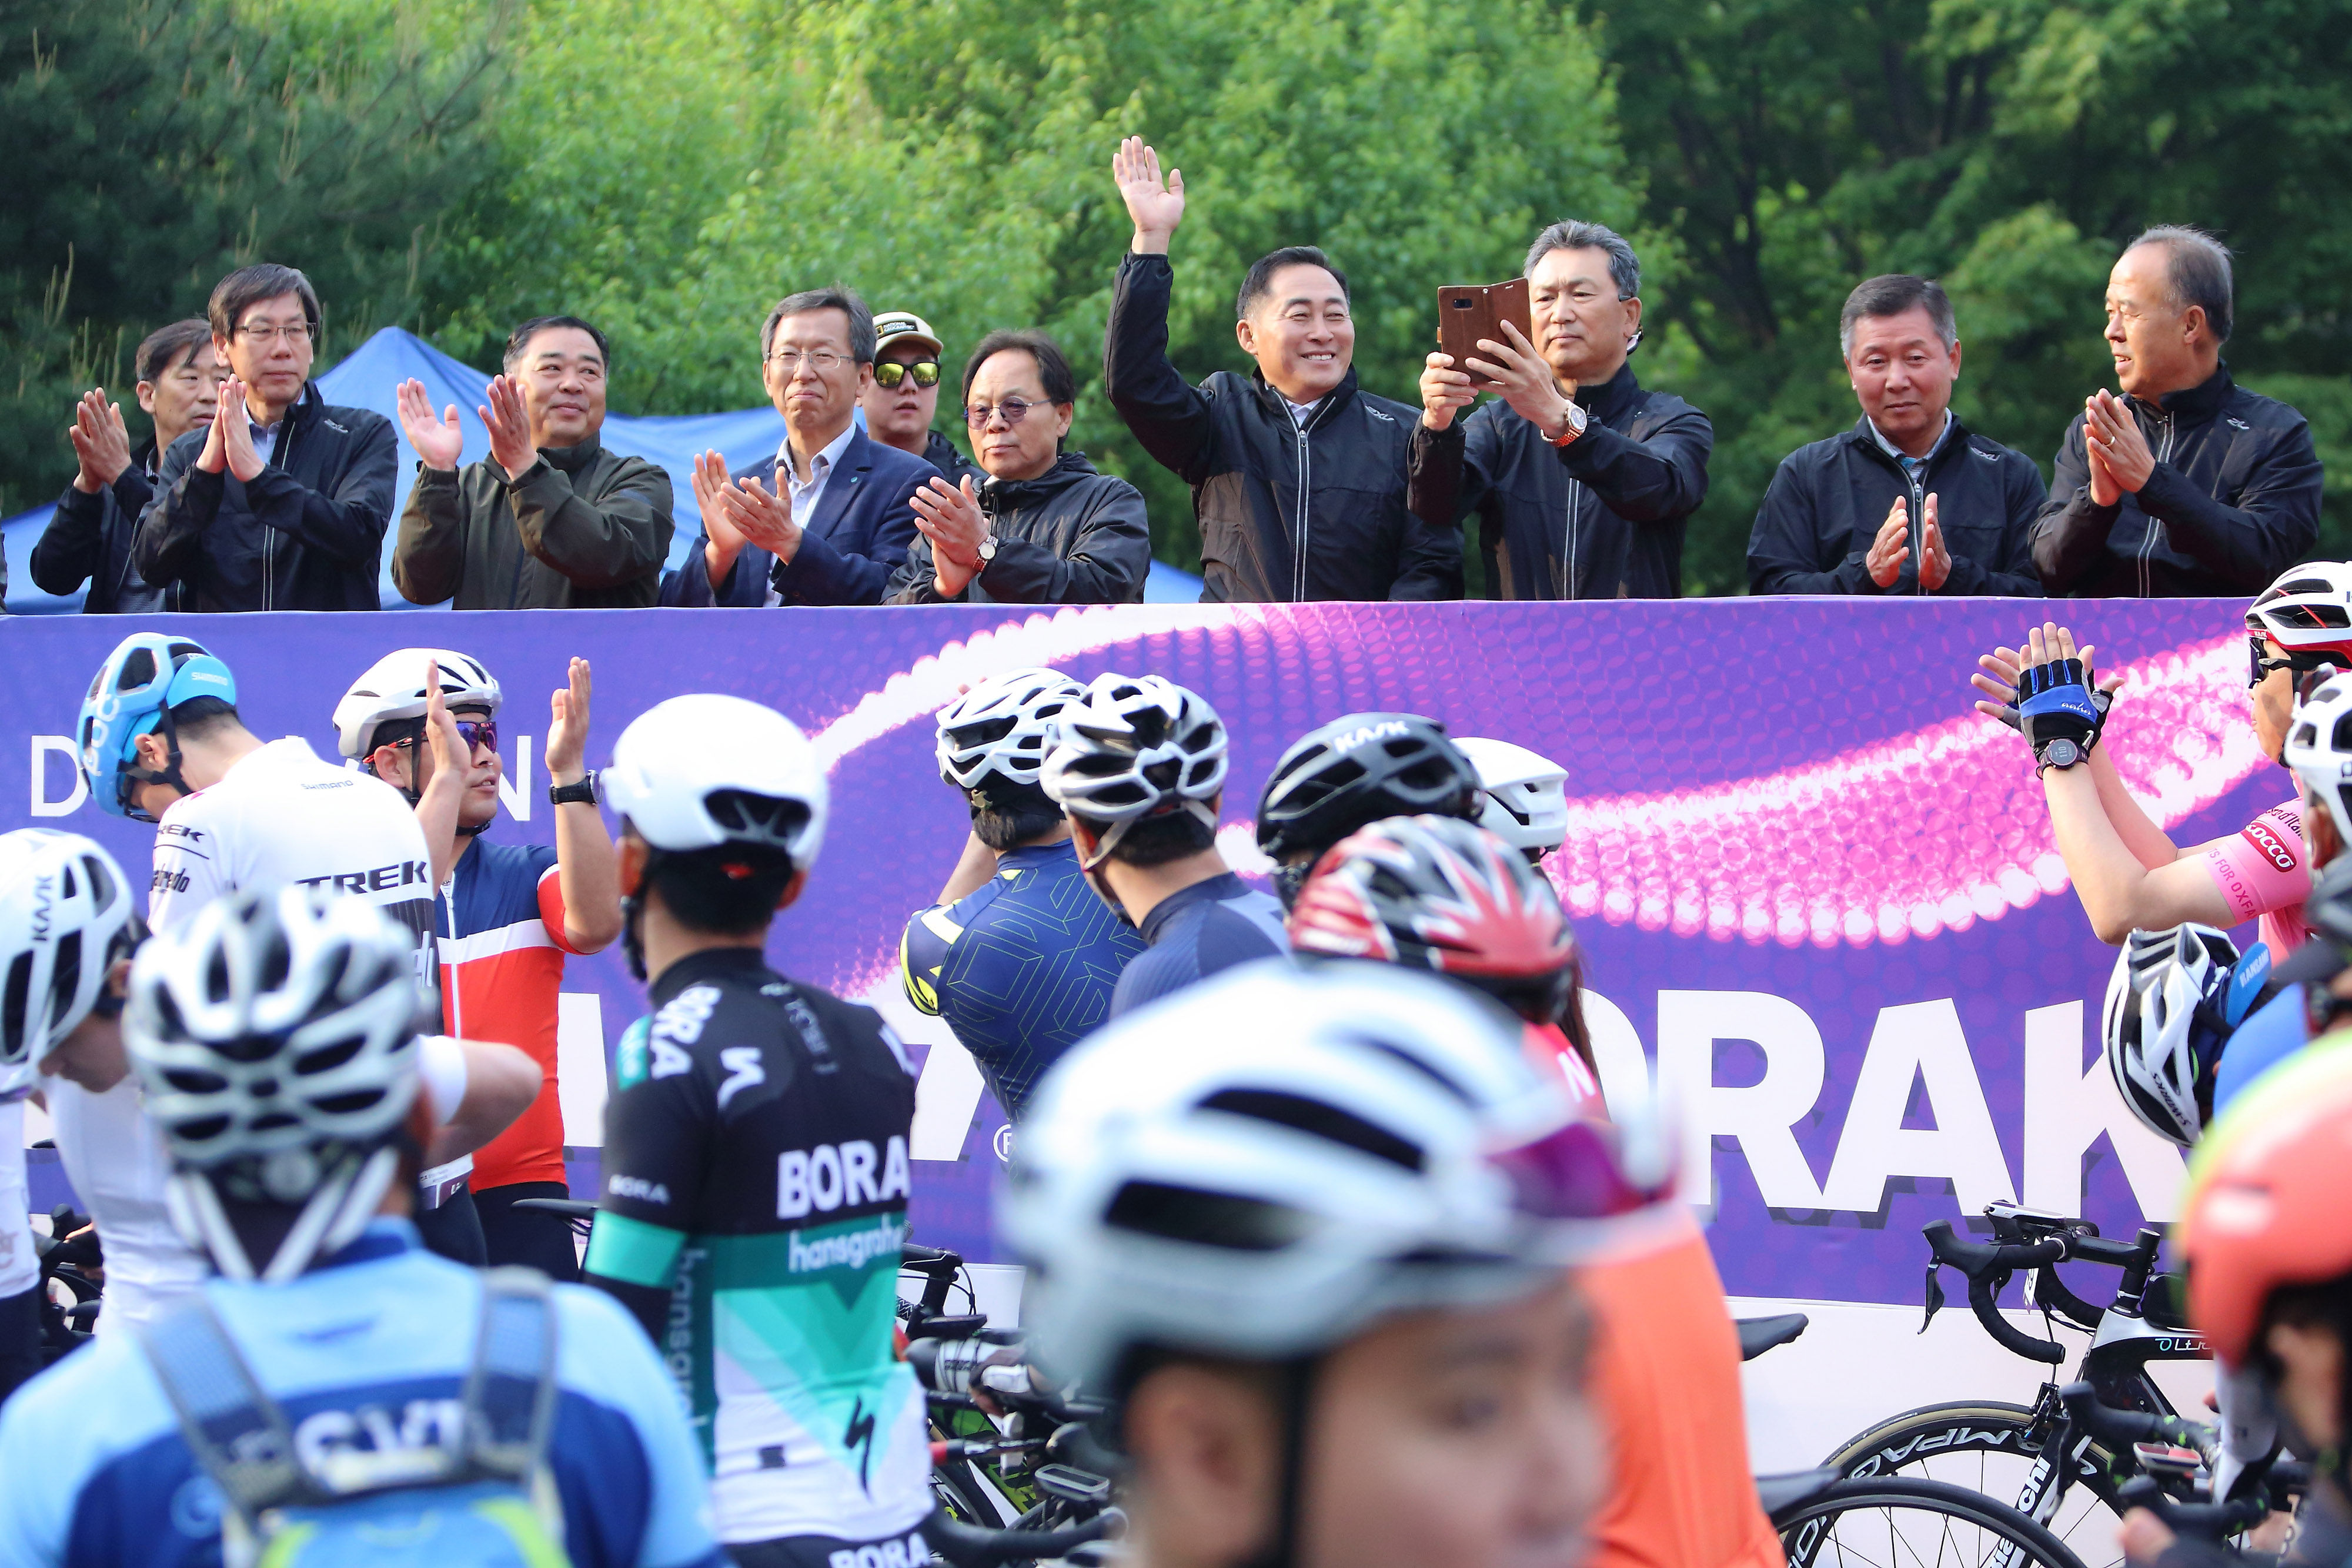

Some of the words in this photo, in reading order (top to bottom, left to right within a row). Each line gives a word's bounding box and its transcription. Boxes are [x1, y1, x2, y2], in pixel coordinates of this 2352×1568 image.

[83, 693, 120, 777] POC
[300, 780, 353, 790] SHIMANO
[293, 861, 427, 895] TREK
[2215, 858, 2235, 881] FOR
[609, 1174, 671, 1205] BORA
[777, 1135, 911, 1220] BORA
